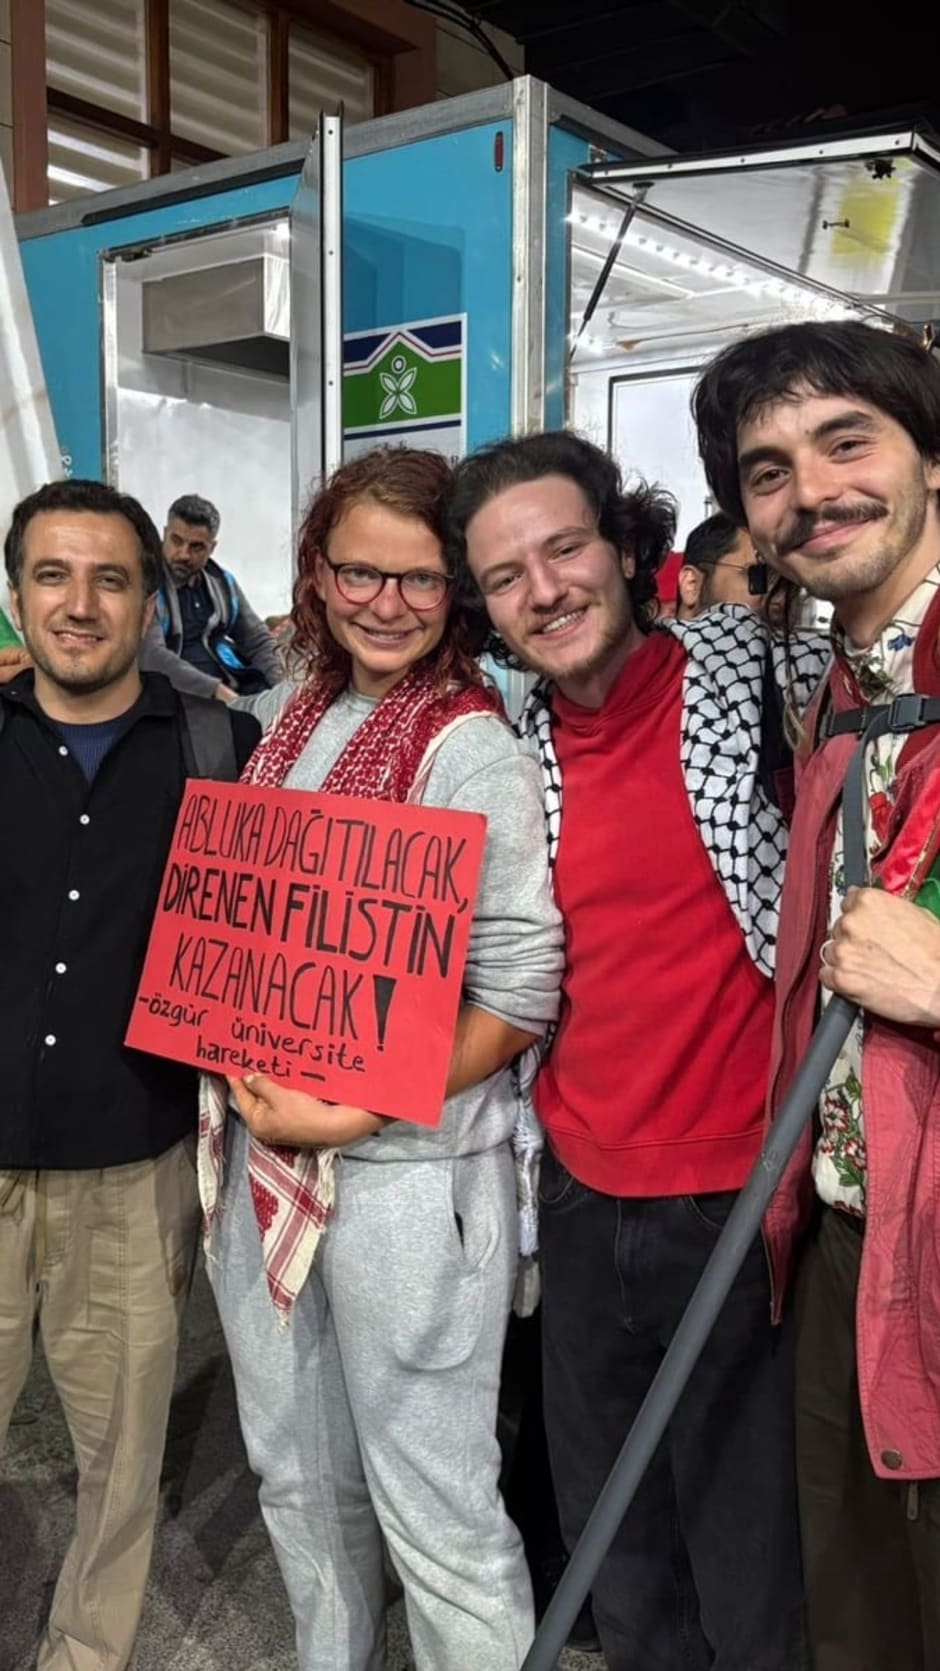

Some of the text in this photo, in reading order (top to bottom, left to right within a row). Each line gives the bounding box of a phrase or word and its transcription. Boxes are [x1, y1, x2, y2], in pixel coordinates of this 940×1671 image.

[176, 794, 468, 913] ABLUKA DAĞITILACAK,
[163, 863, 456, 978] DİRENEN FİLİSTİN
[195, 1035, 292, 1077] hareketi
[230, 1016, 366, 1073] üniversite
